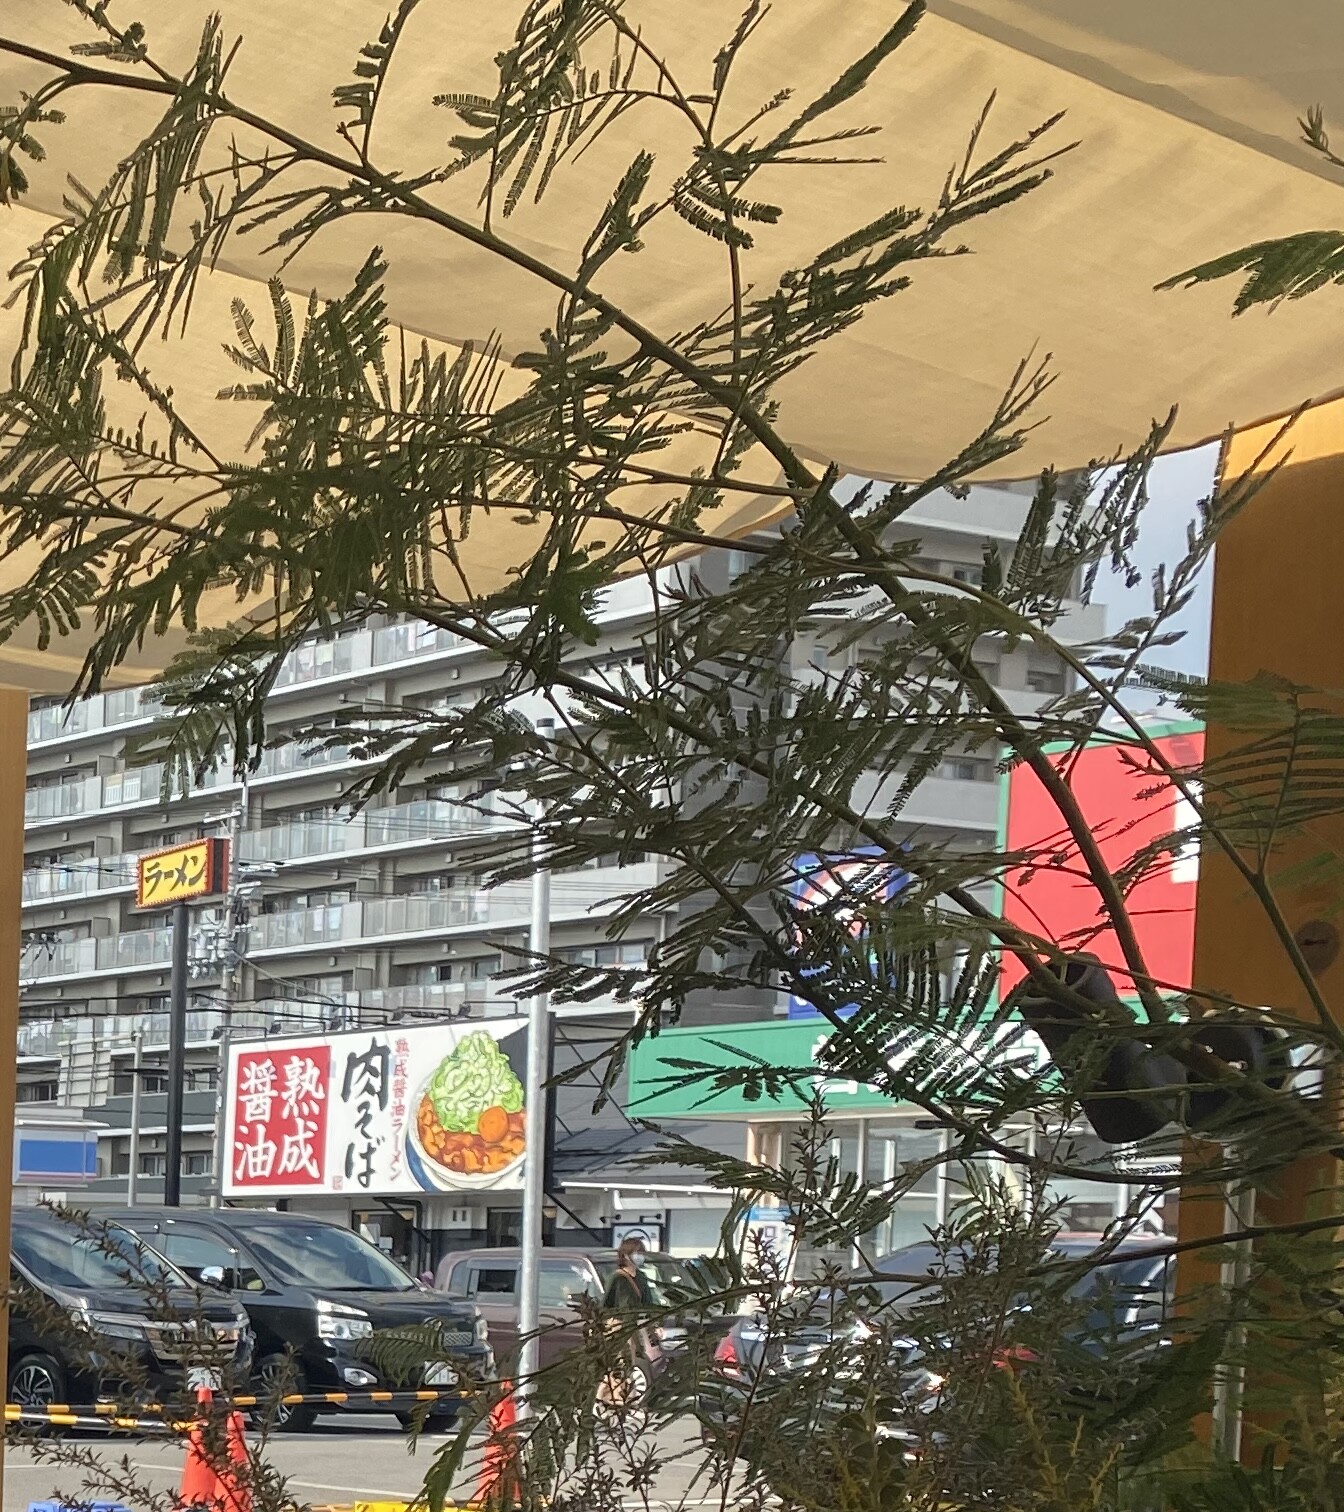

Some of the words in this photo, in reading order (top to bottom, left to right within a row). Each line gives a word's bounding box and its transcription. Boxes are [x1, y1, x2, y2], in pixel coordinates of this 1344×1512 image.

[145, 853, 207, 899] ラーメン
[234, 1058, 279, 1181] 醤油
[279, 1055, 325, 1179] 熟成
[341, 1036, 391, 1188] 肉そば
